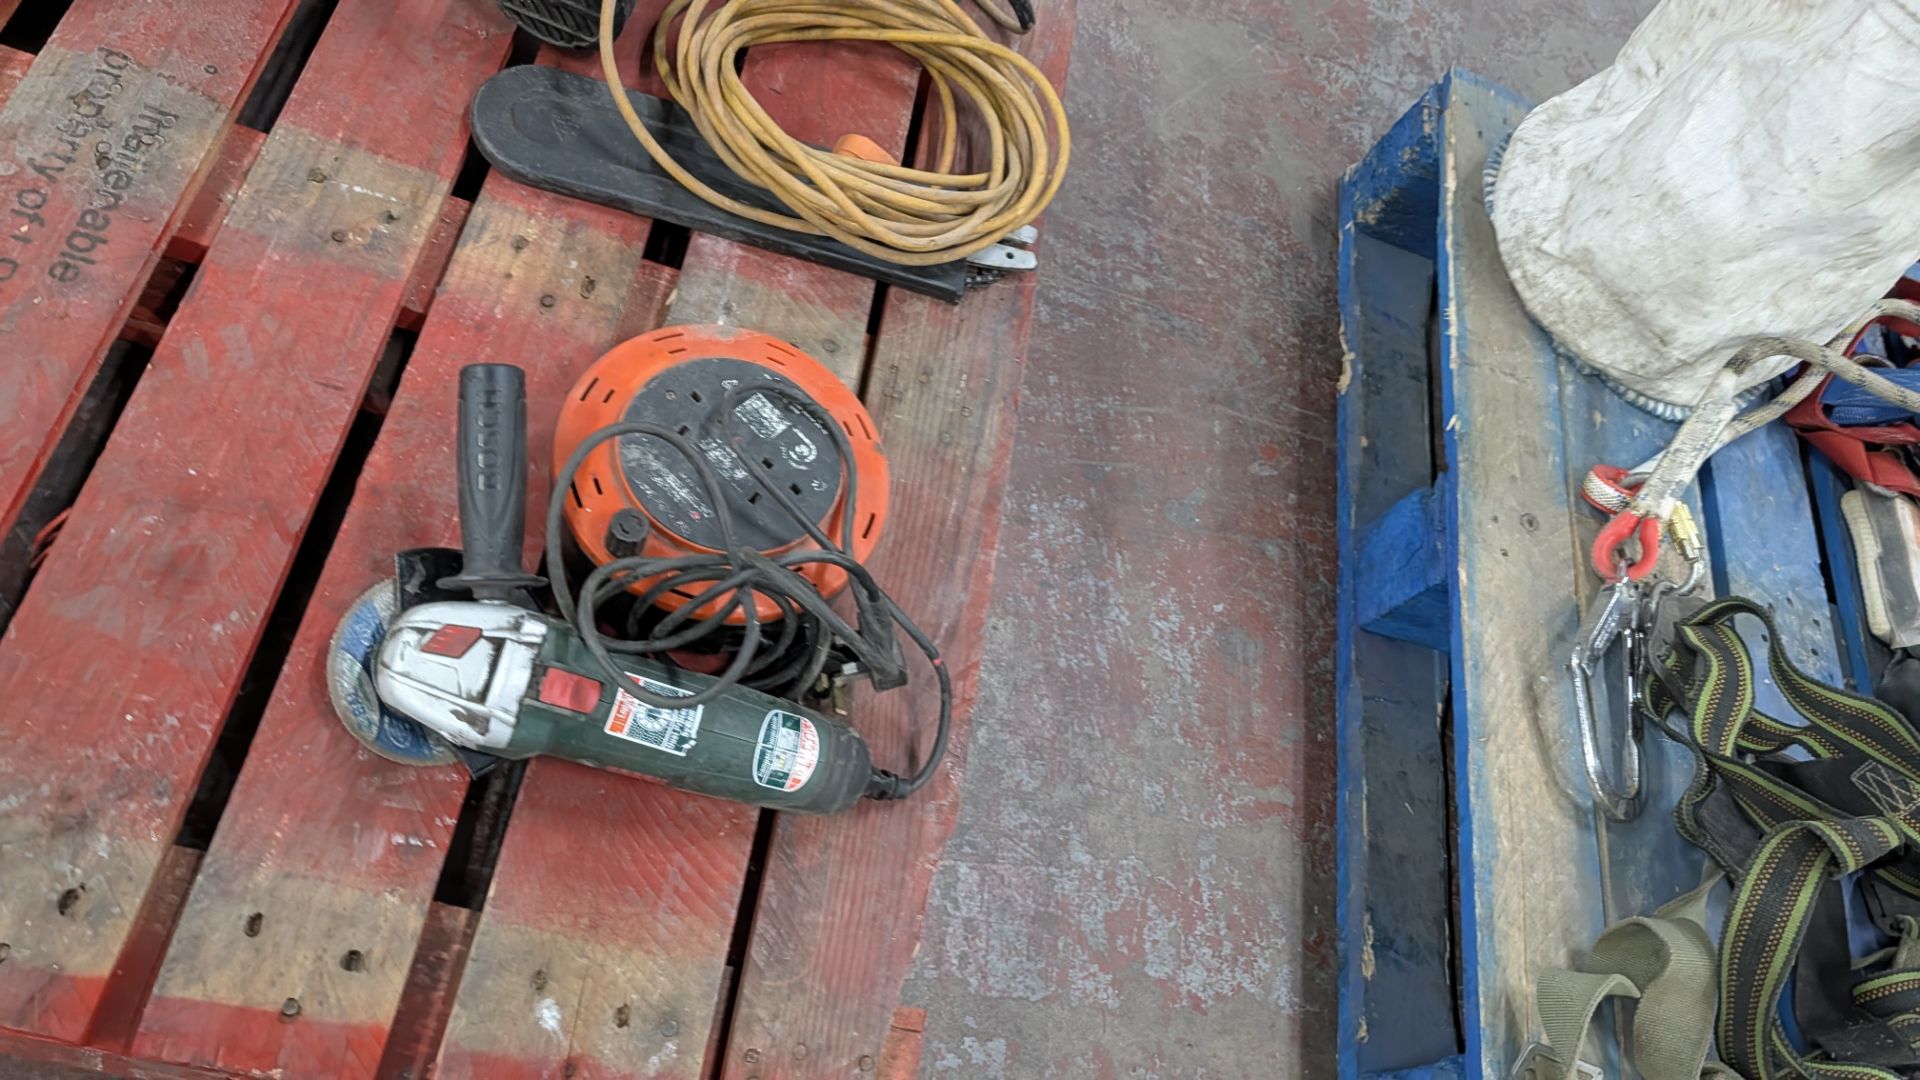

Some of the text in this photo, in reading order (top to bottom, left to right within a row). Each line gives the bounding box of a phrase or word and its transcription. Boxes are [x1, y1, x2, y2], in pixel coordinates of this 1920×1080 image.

[26, 46, 132, 183] property
[11, 188, 47, 227] of
[476, 389, 501, 490] BOSCH
